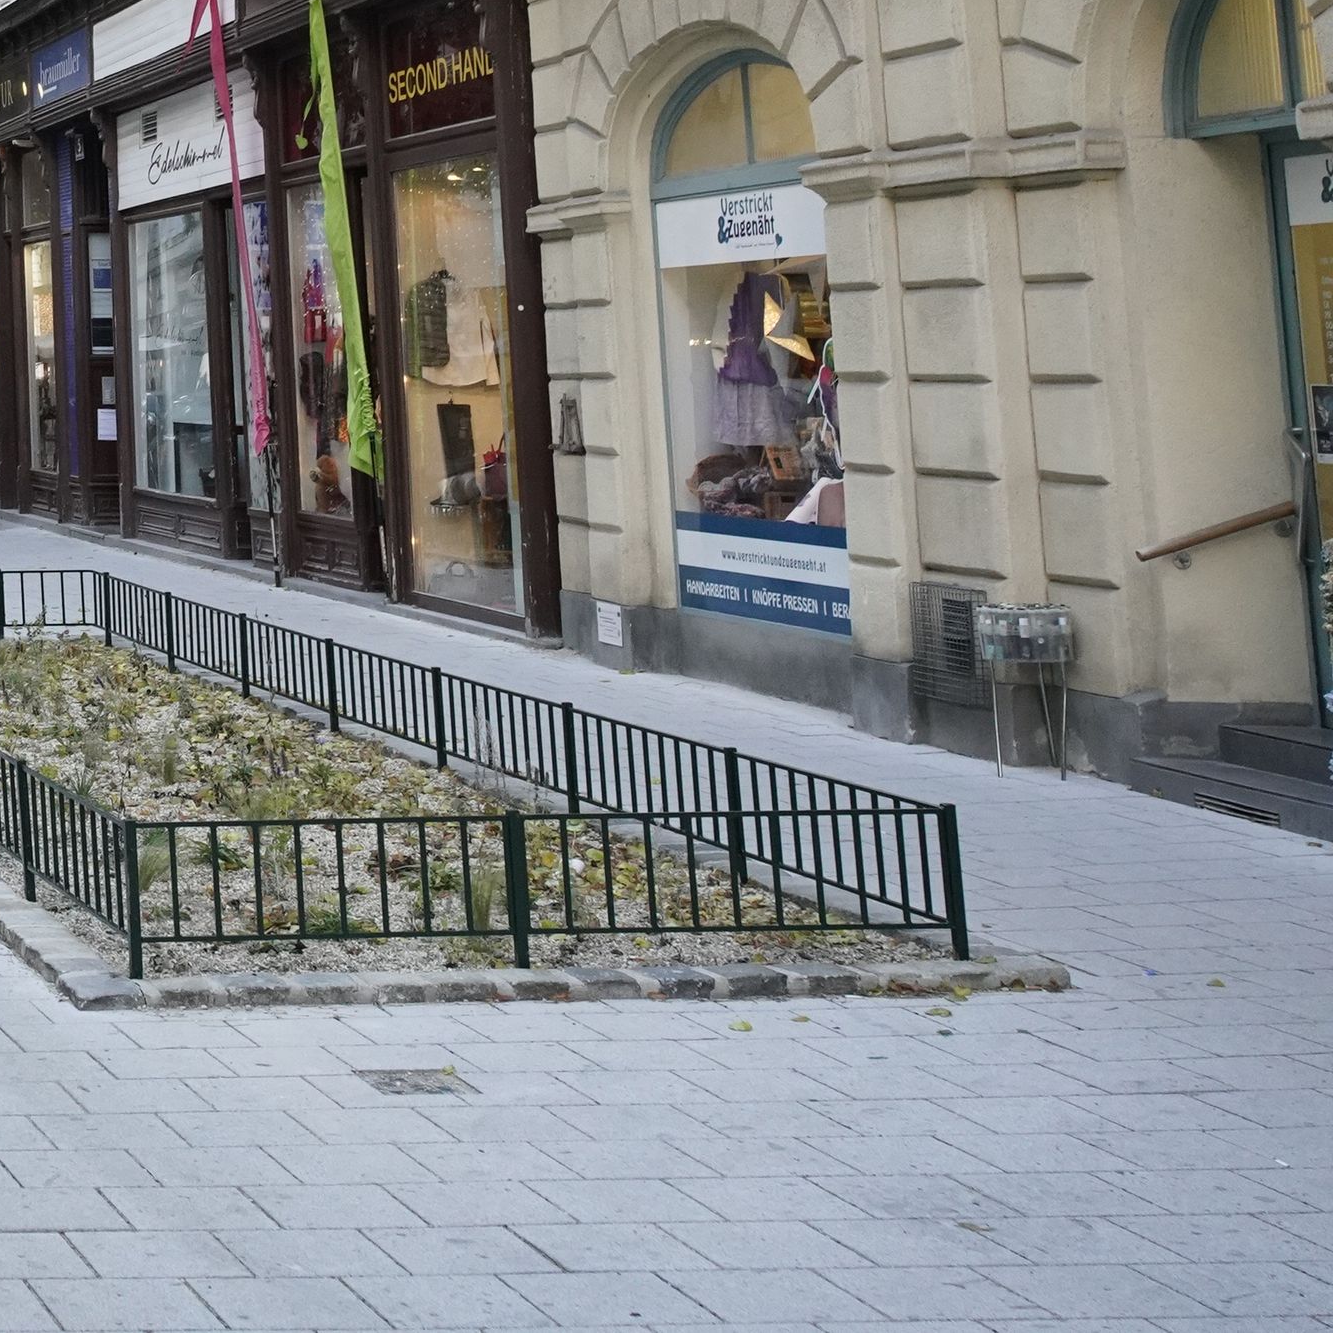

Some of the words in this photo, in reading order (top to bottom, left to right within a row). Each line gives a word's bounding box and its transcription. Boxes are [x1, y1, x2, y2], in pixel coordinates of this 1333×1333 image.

[39, 47, 81, 87] braumüller
[388, 57, 448, 104] SECOND
[147, 125, 225, 185] Edelschimmel
[720, 191, 773, 217] Verstrickt
[686, 578, 740, 601] HANDARBEITEN
[752, 587, 782, 609] KNÖPFE
[782, 595, 819, 614] PRESSEN
[832, 602, 851, 619] BER
